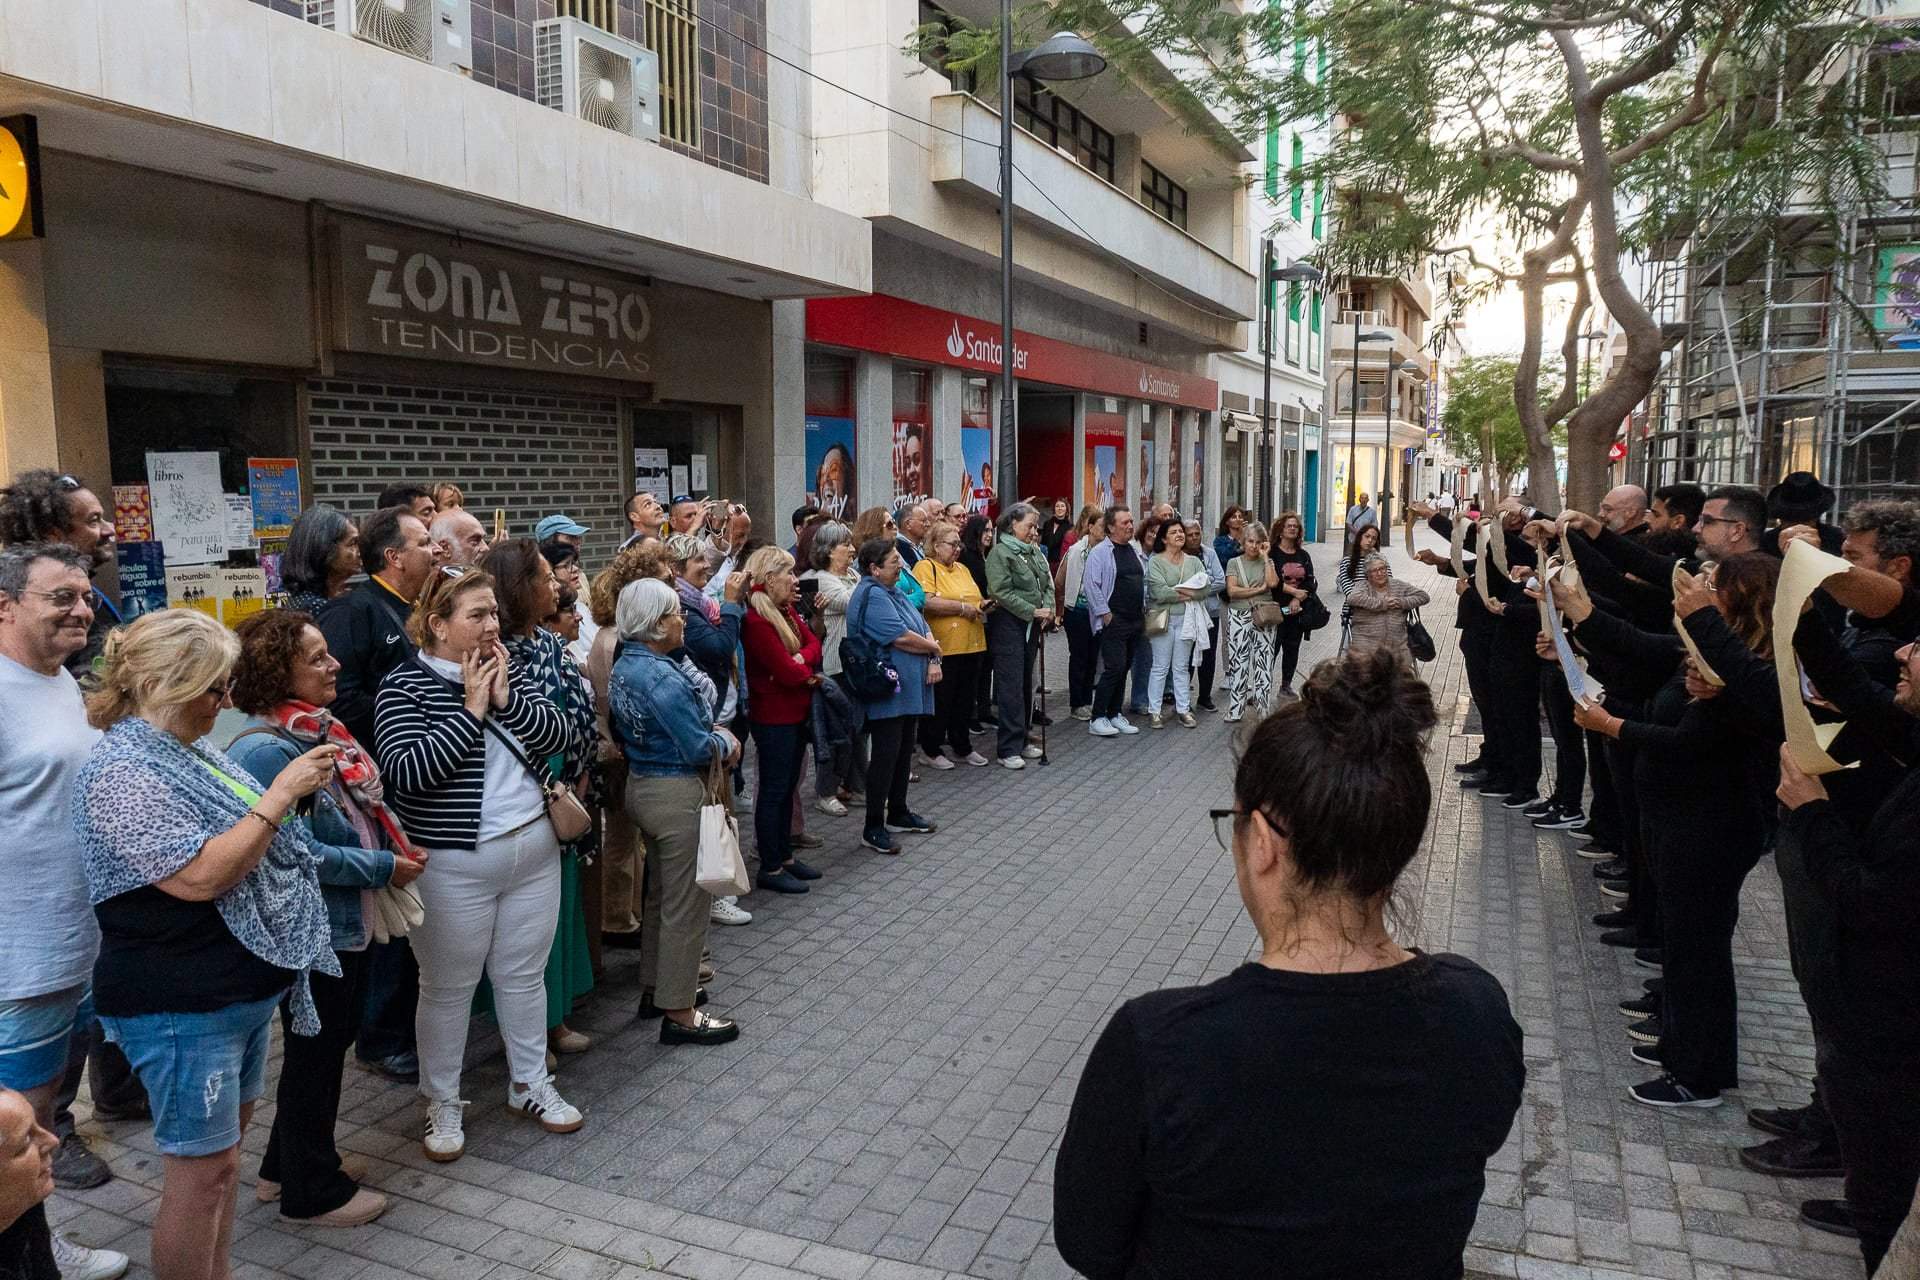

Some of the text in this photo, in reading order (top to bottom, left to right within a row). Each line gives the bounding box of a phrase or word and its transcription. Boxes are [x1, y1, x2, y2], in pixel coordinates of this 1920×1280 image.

[366, 244, 650, 344] ZONA ZERO
[372, 316, 650, 373] TENDENCIAS
[966, 331, 1029, 370] Santader
[154, 470, 184, 481] libros
[181, 535, 203, 549] para
[206, 543, 223, 555] isla
[135, 578, 157, 588] sobre
